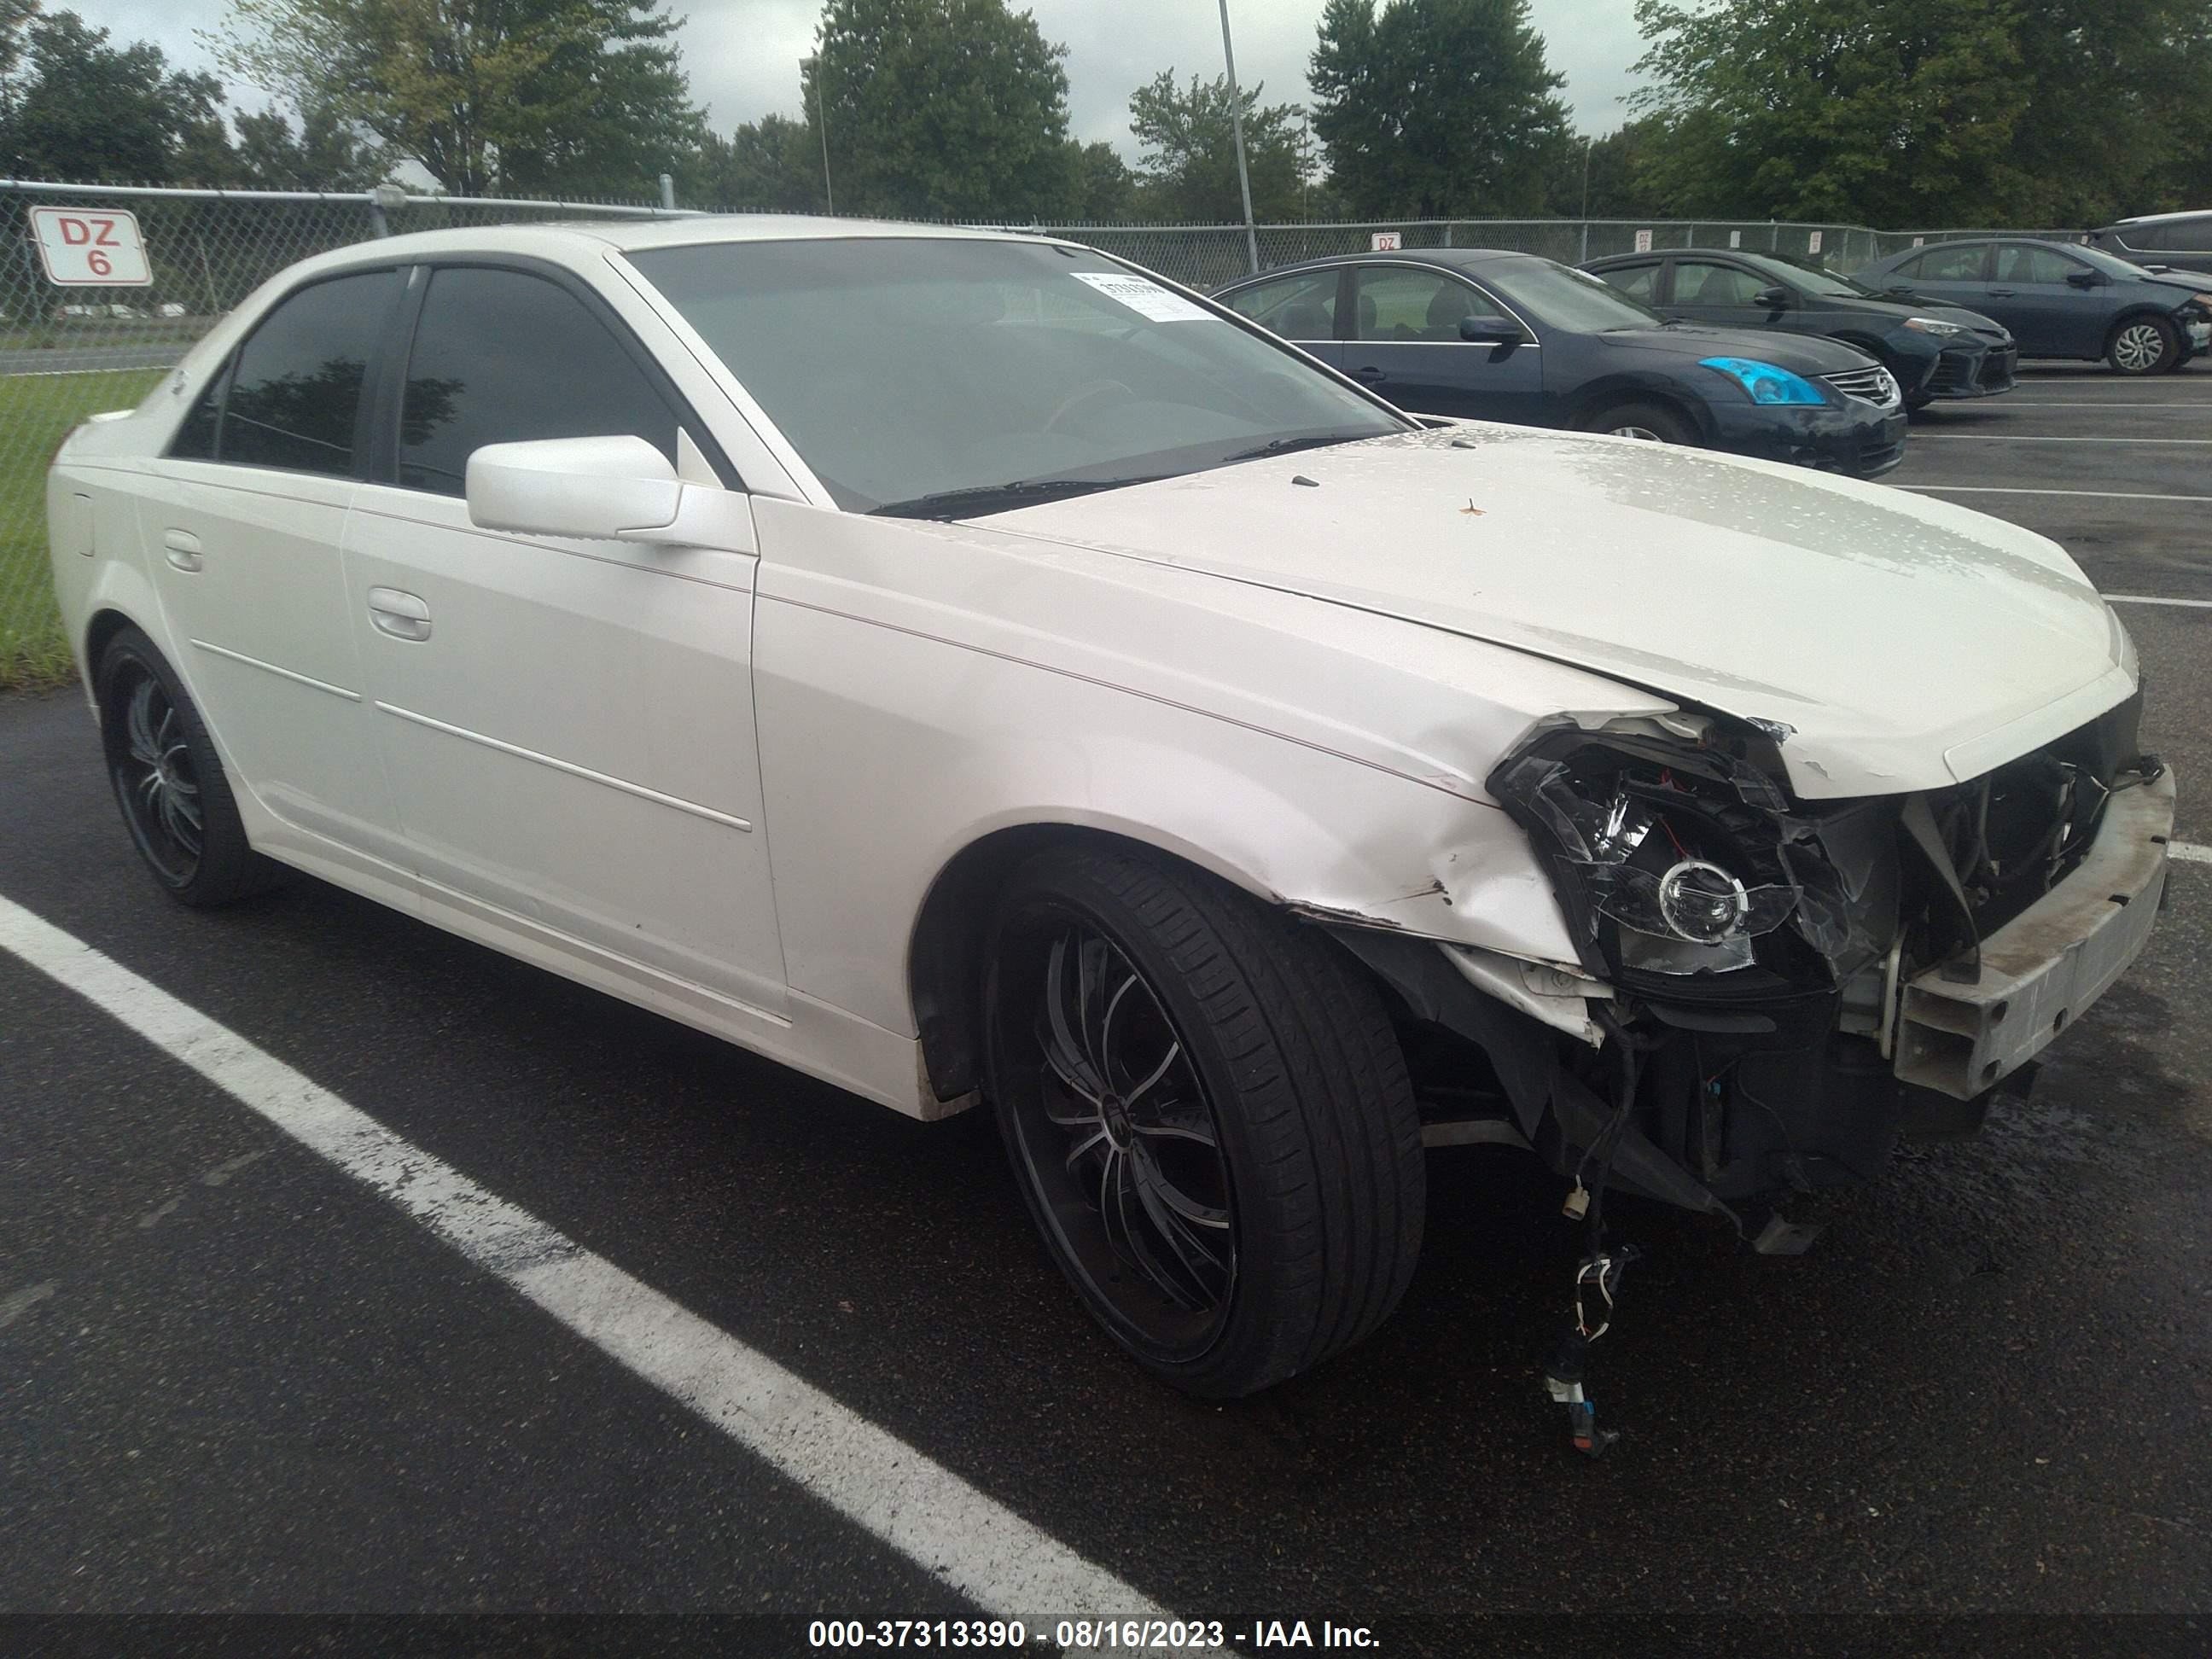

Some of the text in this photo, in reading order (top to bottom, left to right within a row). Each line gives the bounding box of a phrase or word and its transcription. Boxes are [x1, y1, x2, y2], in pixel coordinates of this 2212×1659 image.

[58, 218, 120, 247] DZ
[1379, 237, 1394, 251] DZ
[88, 250, 112, 276] 6
